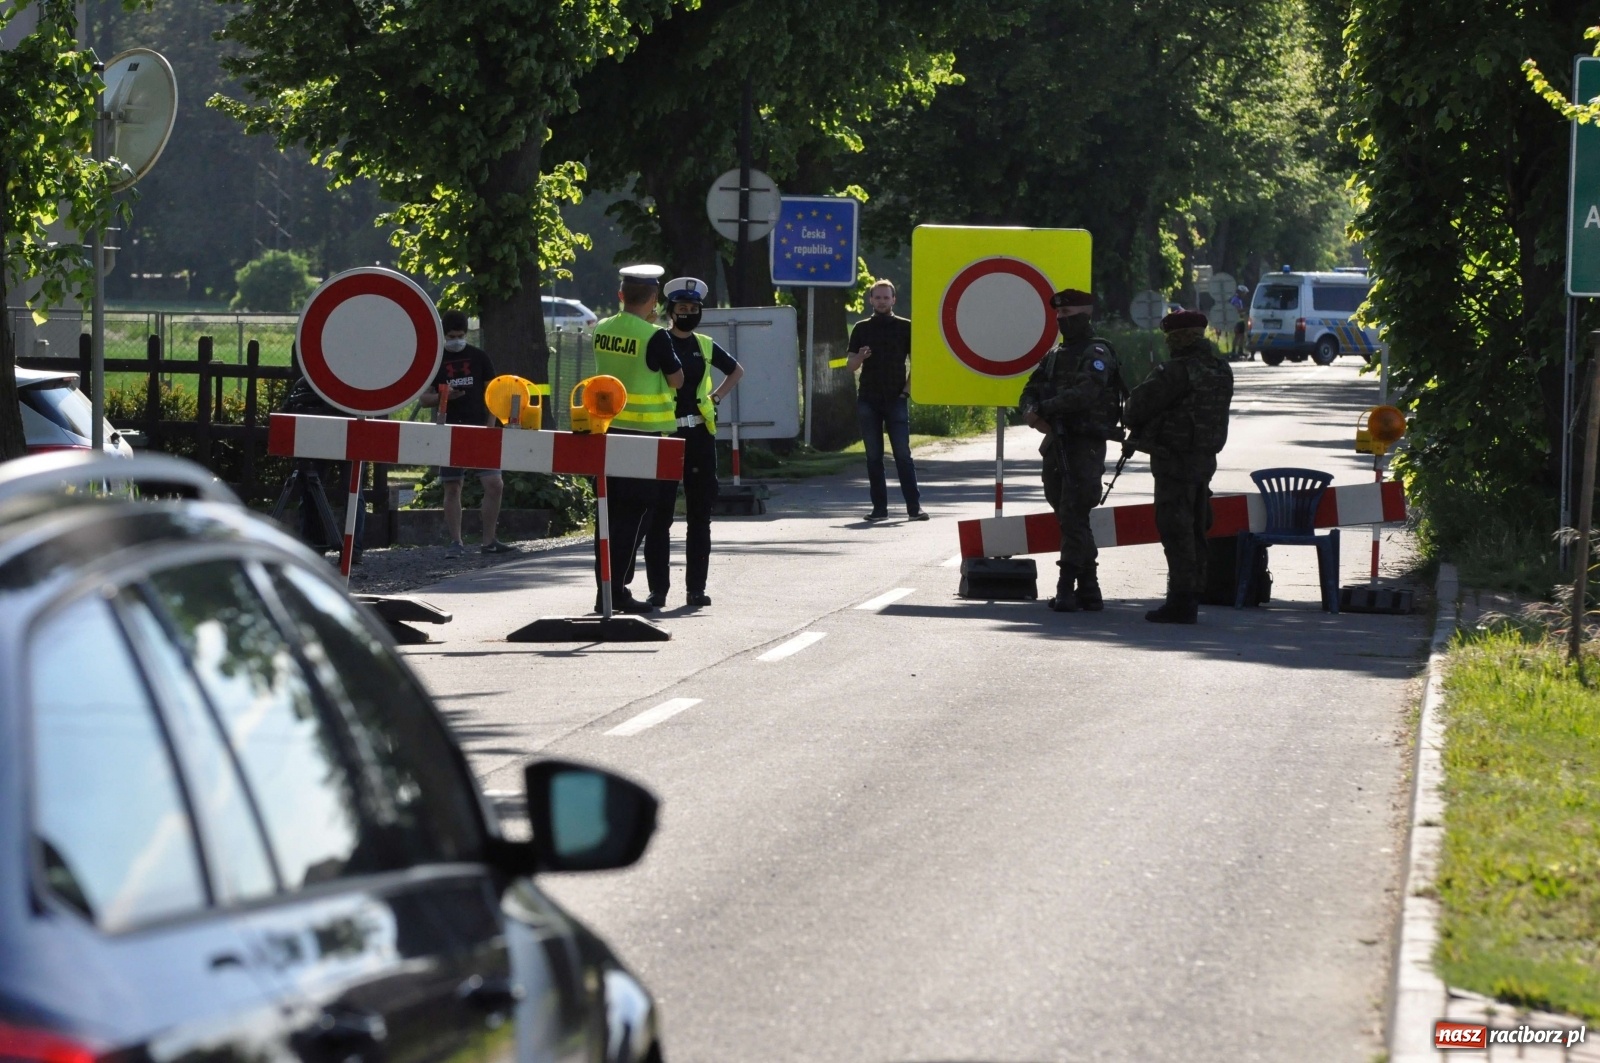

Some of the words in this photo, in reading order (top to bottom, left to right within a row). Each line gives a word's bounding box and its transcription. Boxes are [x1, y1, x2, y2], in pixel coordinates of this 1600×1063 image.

[801, 226, 826, 239] Česká
[793, 244, 833, 257] republika
[594, 333, 637, 355] POLICJA
